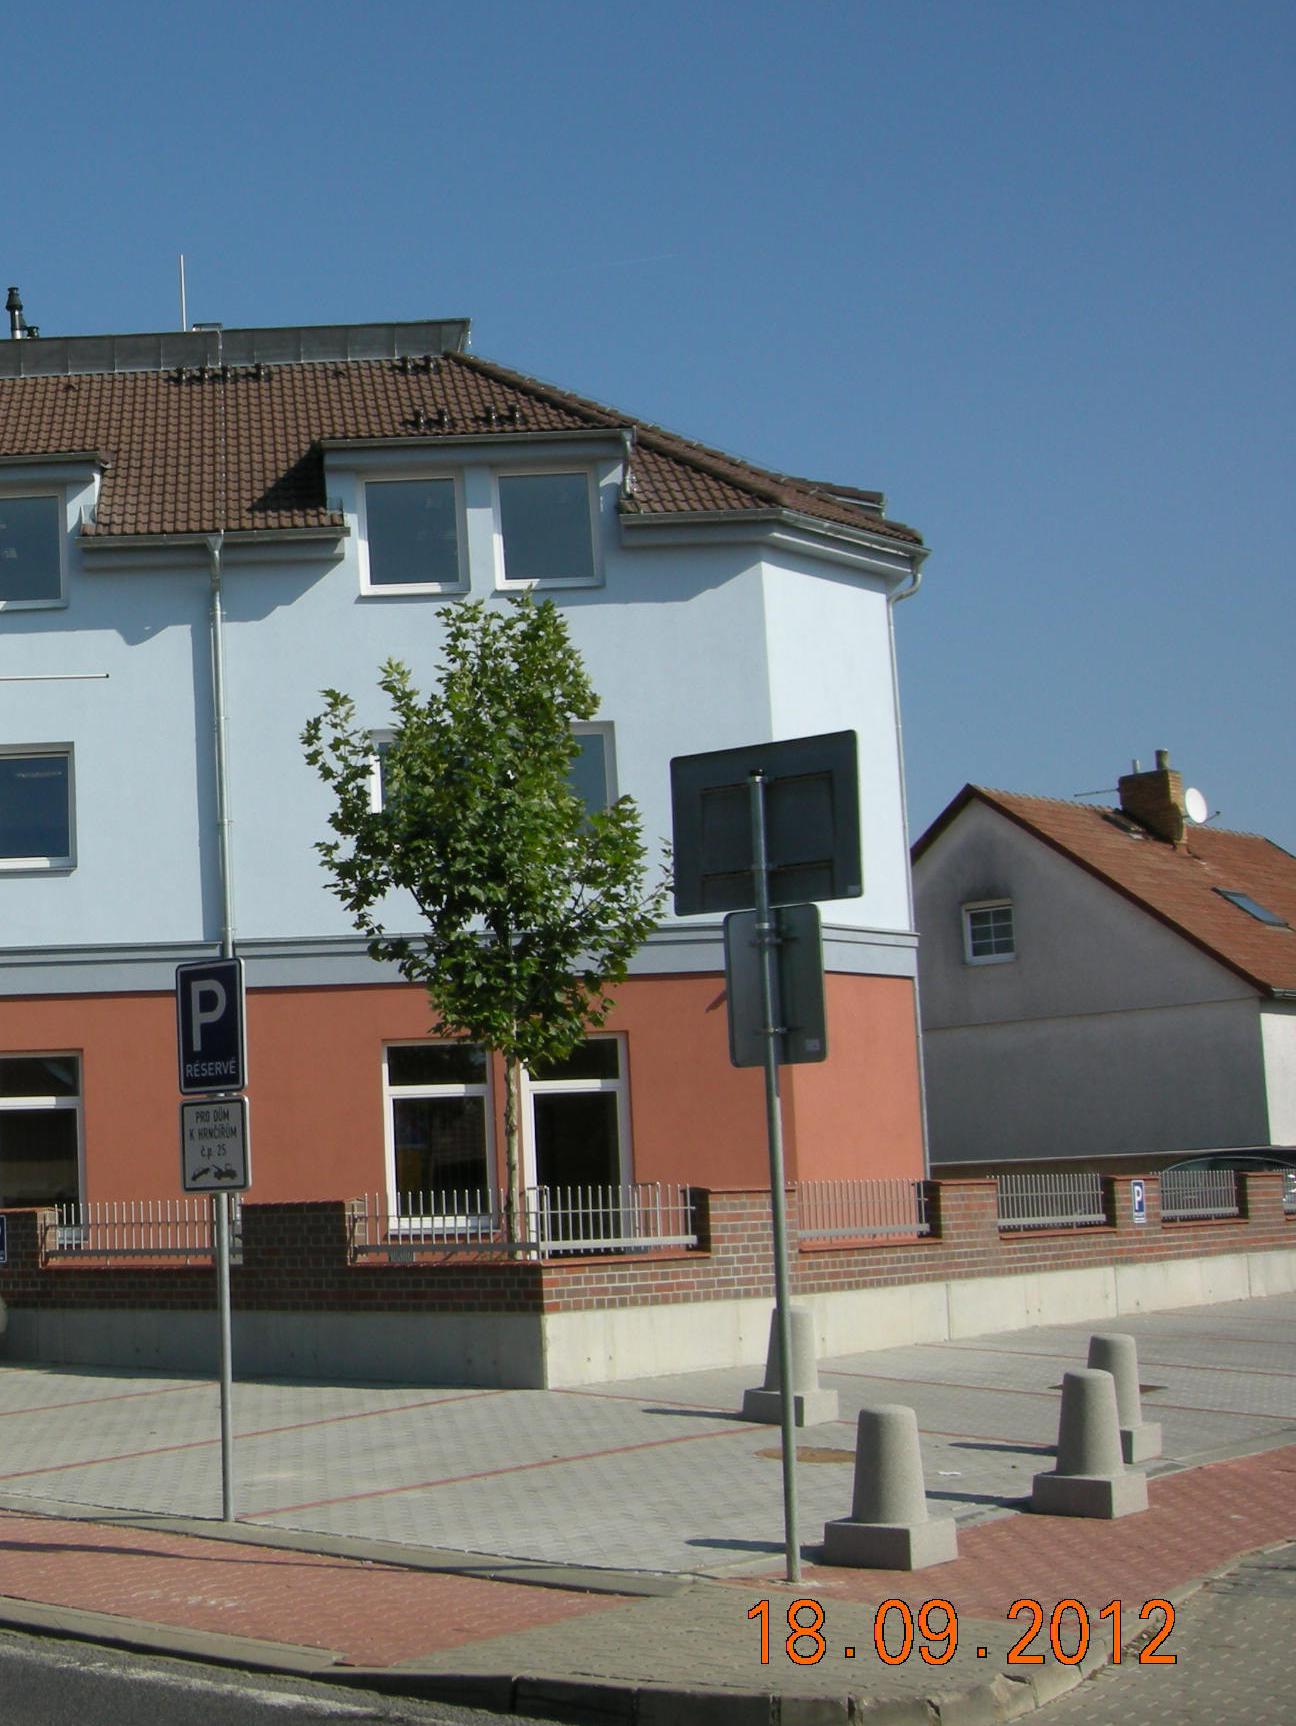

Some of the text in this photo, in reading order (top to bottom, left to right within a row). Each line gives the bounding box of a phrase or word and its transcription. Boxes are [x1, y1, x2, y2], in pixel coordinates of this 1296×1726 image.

[190, 979, 226, 1052] P
[185, 1057, 237, 1078] RÉSERVÉ
[194, 1110, 210, 1124] PRO
[189, 1127, 195, 1140] K
[216, 1143, 227, 1157] 25
[1134, 1185, 1143, 1210] P
